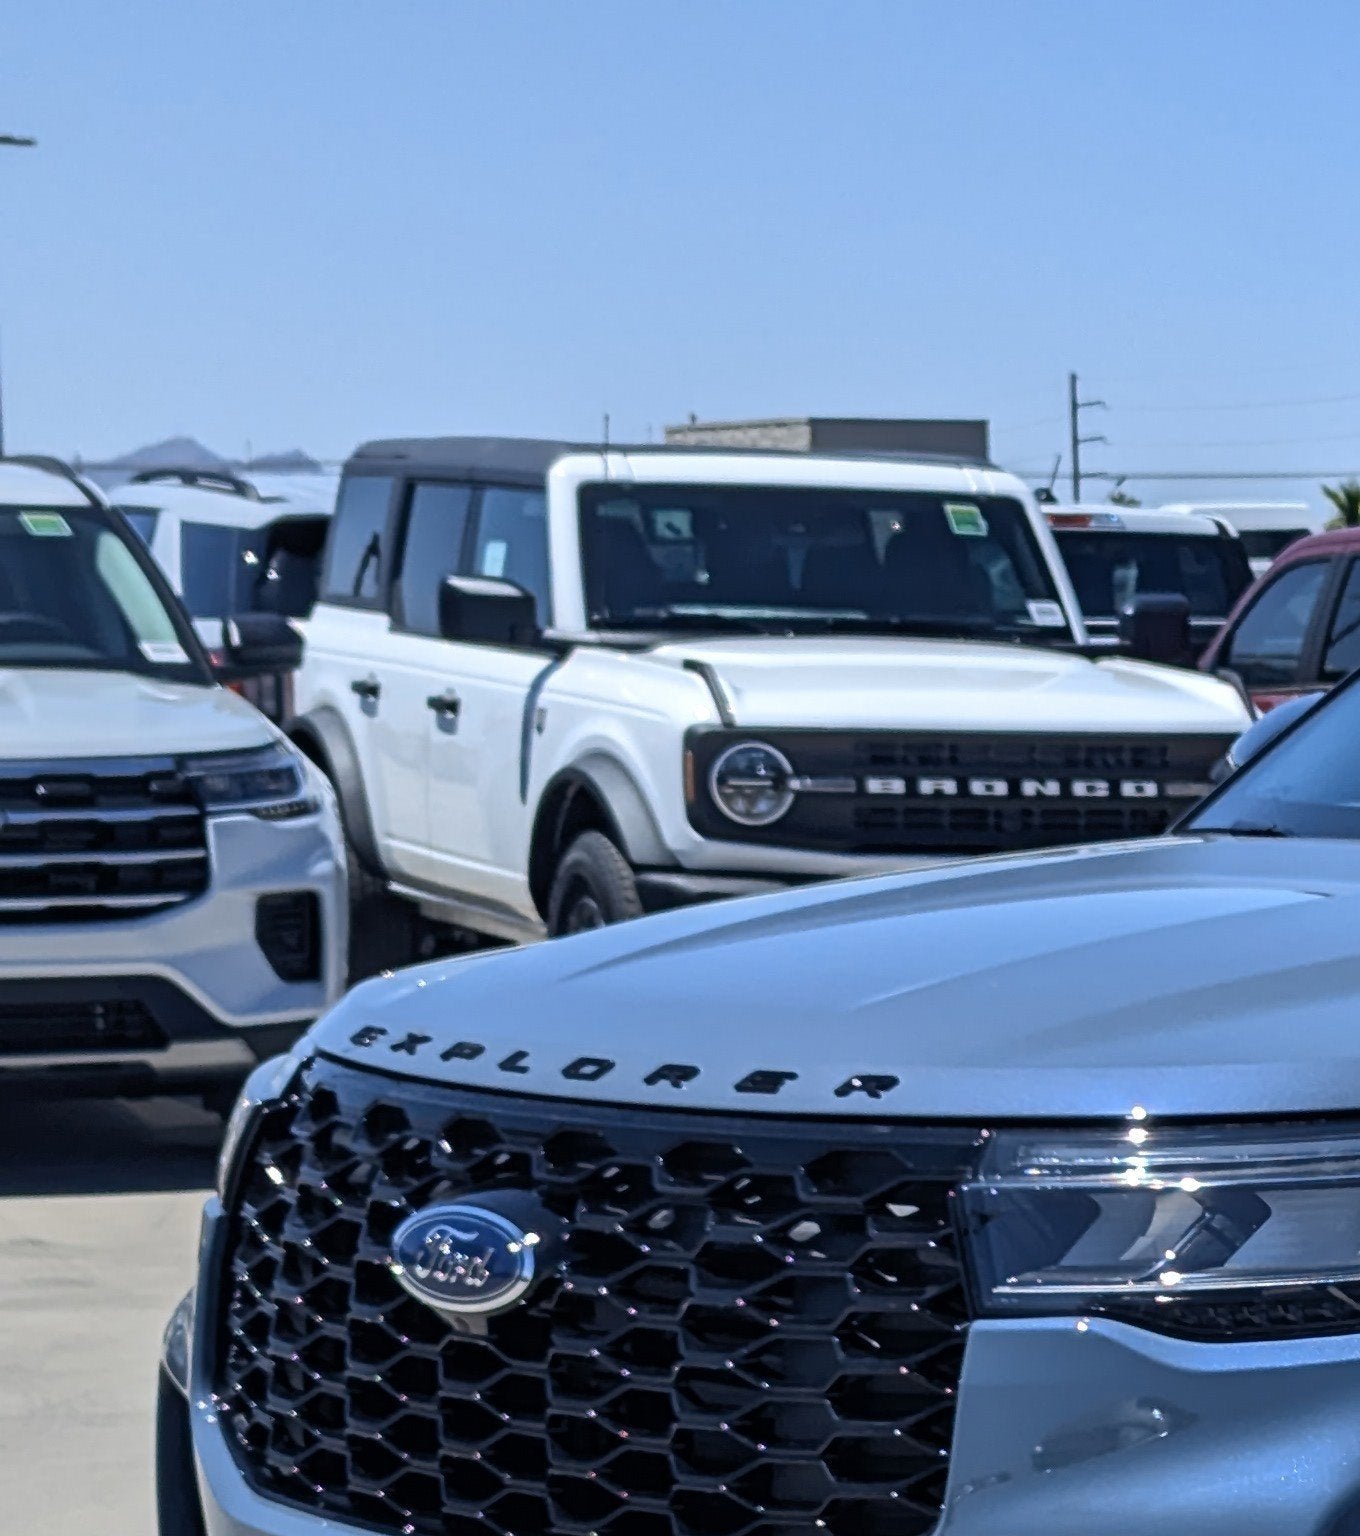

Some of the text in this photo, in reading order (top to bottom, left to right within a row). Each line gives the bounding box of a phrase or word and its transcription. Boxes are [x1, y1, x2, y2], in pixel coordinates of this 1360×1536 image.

[865, 777, 1159, 798] BRONCO
[349, 1026, 901, 1099] EXPLORER
[411, 1223, 497, 1288] Ford
